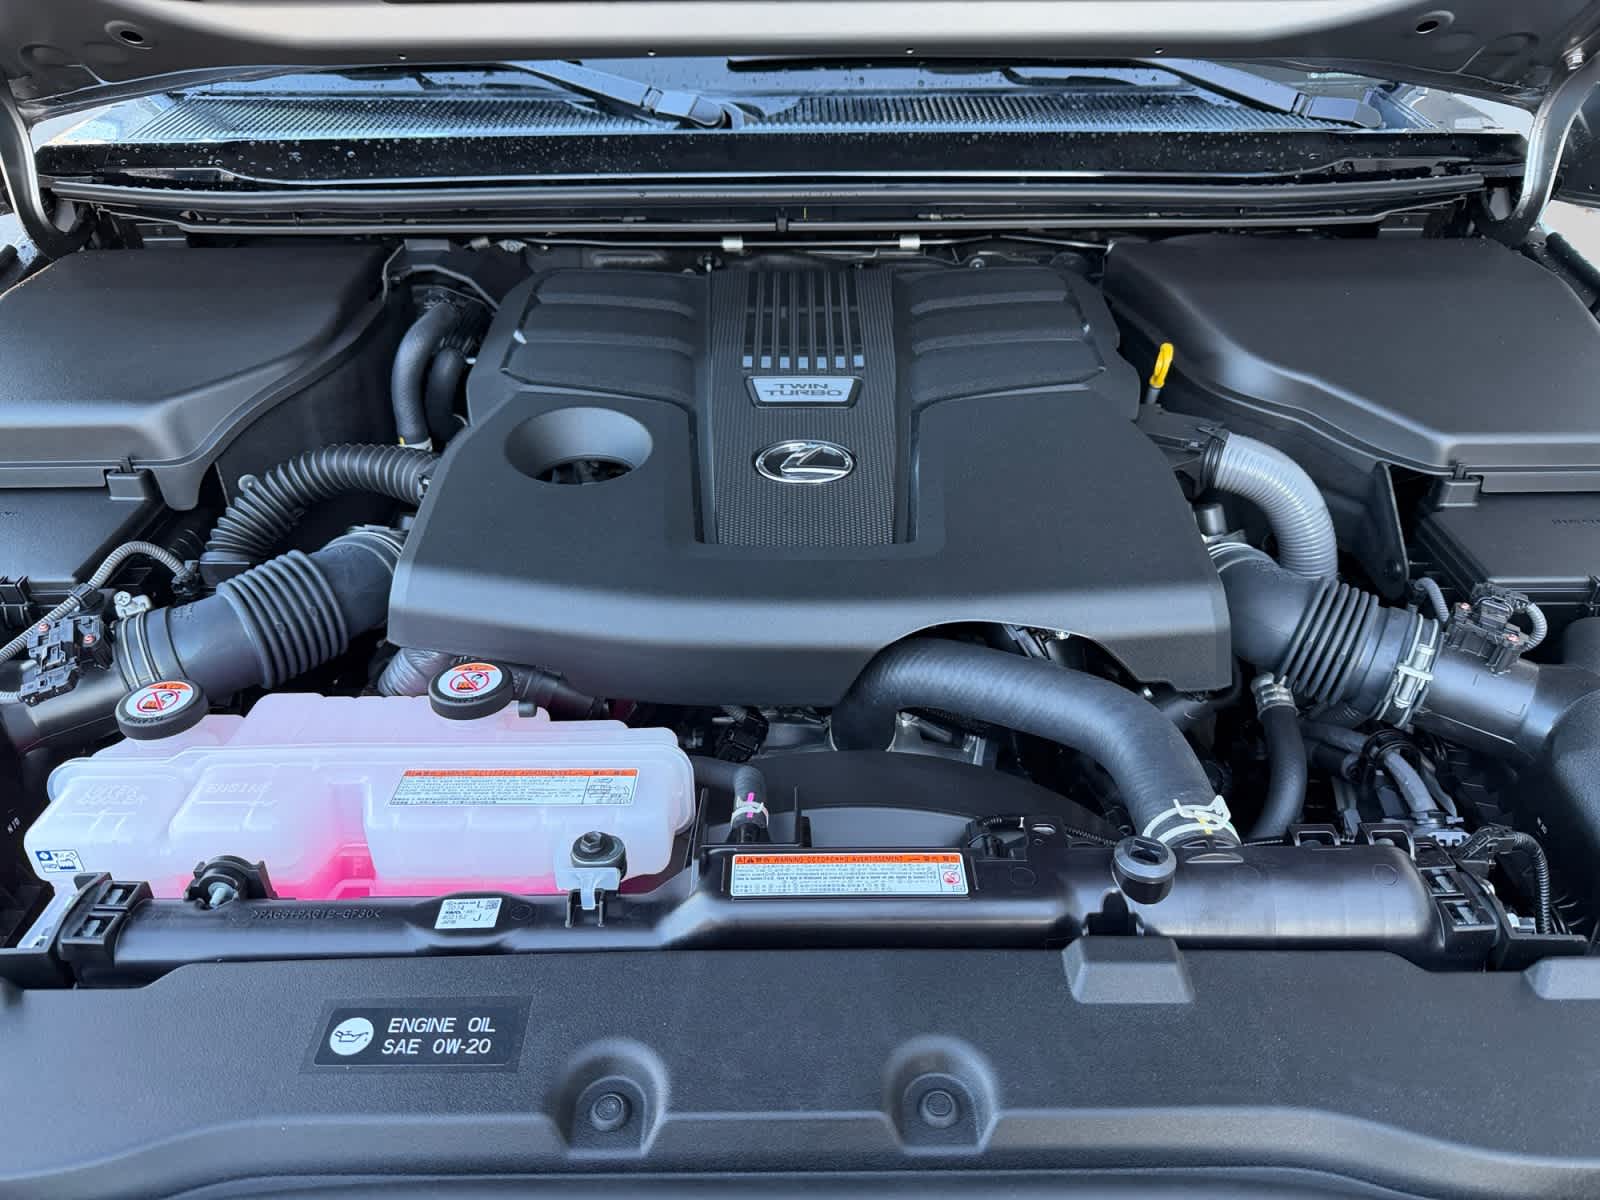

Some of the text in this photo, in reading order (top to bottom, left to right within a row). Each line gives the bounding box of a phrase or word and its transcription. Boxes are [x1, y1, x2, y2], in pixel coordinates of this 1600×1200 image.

[763, 389, 842, 397] TURBO
[387, 1017, 497, 1033] ENGINE OIL
[381, 1038, 492, 1054] SAE 0W-20
